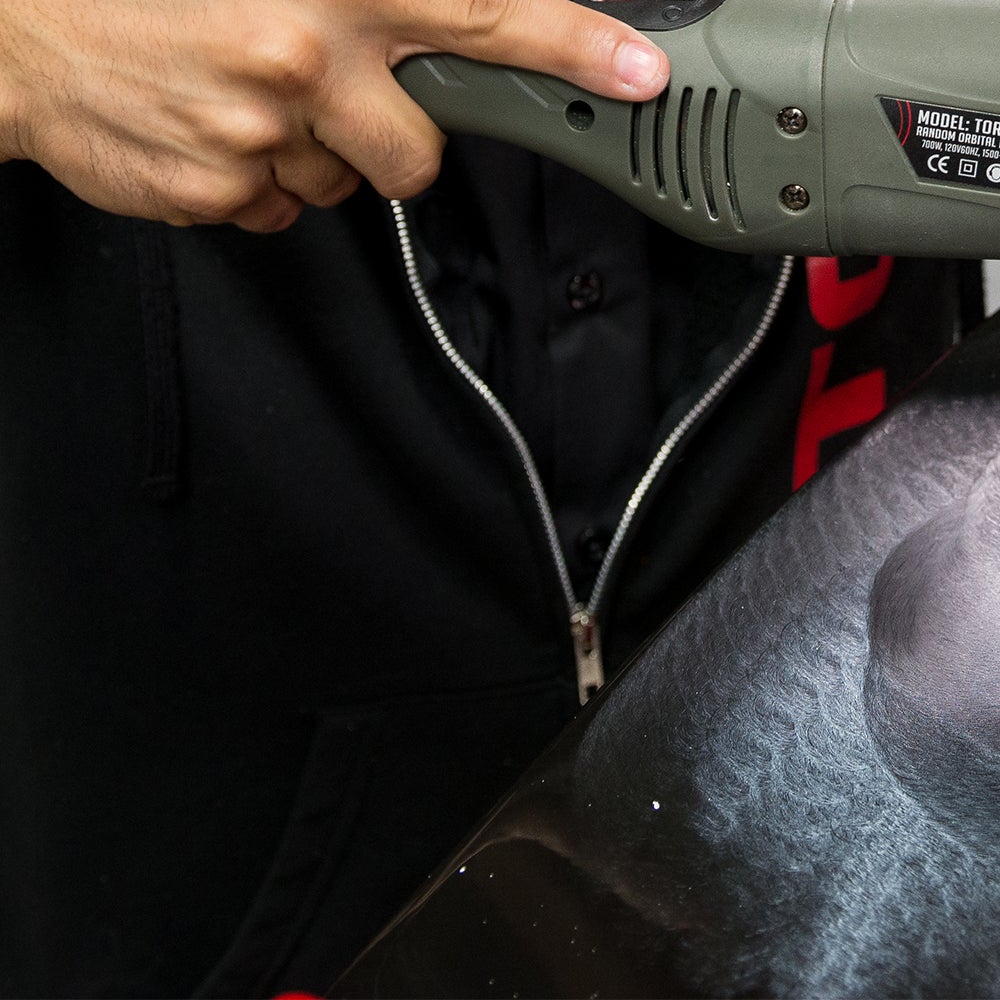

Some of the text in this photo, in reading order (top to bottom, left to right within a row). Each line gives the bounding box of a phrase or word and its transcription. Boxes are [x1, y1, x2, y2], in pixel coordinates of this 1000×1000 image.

[917, 109, 970, 132] MODEL:
[915, 125, 956, 142] RANDOM
[958, 132, 997, 148] ORBITAL
[921, 139, 943, 152] 700W,
[927, 154, 950, 174] CE
